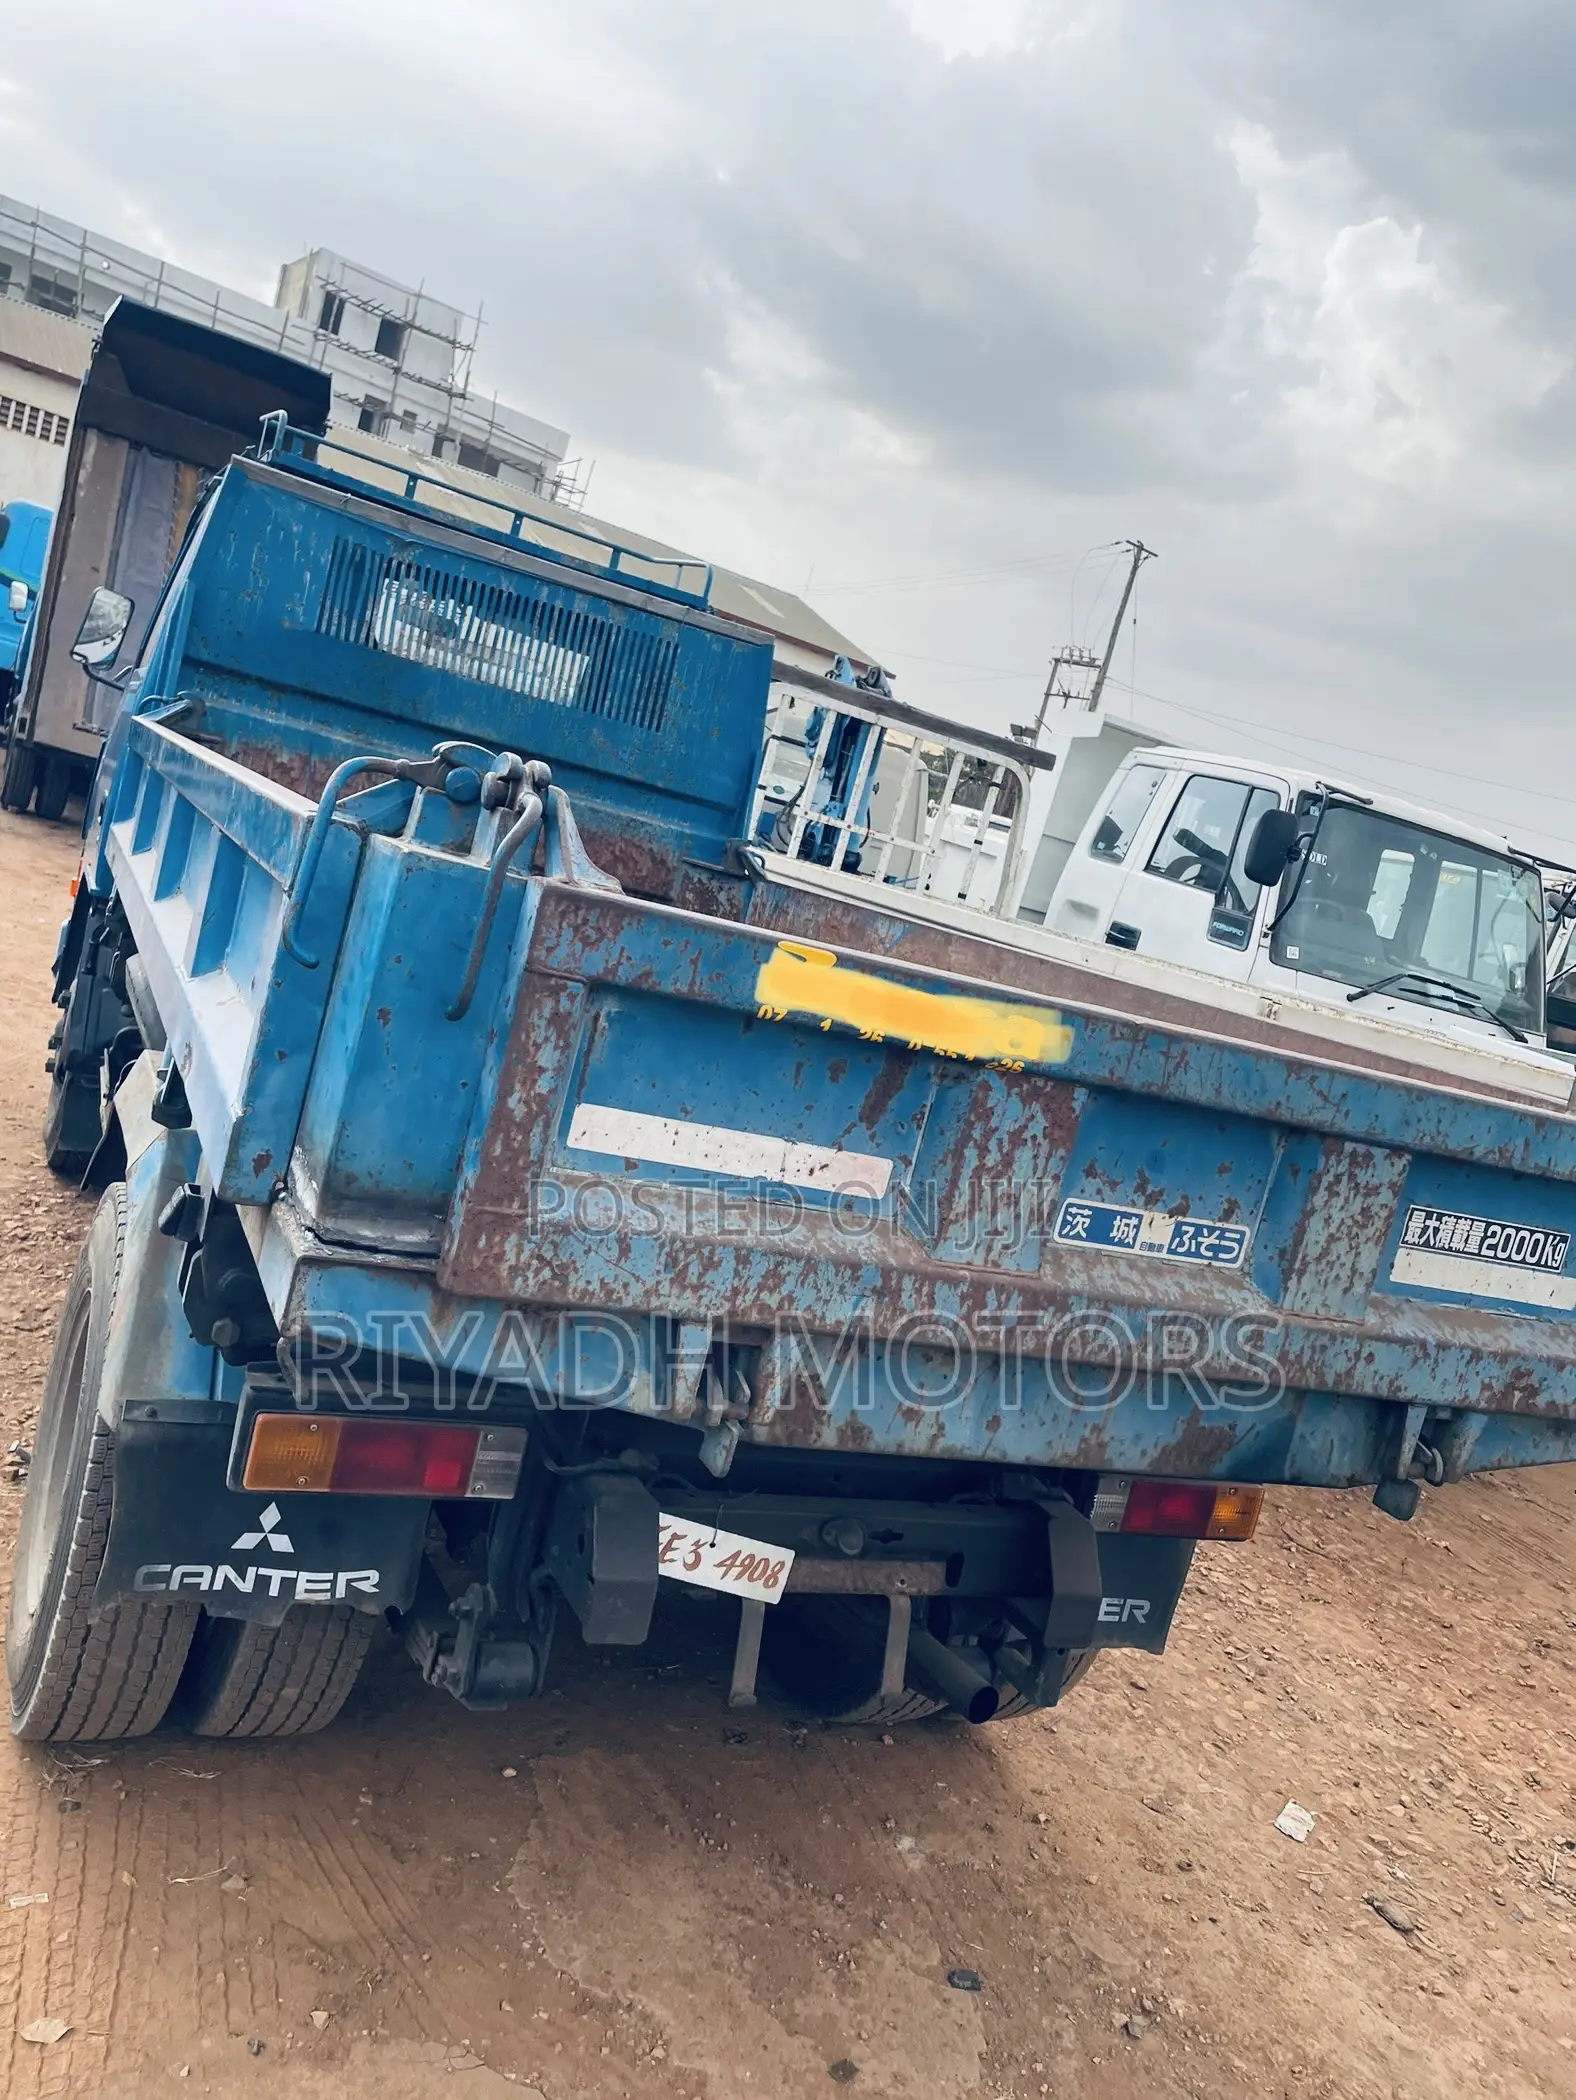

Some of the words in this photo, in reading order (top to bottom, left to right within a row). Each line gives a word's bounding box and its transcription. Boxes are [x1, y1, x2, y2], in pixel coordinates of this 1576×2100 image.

[1166, 1225, 1241, 1260] ふそう
[657, 1524, 710, 1572] E3
[712, 1549, 786, 1590] 4908
[133, 1563, 380, 1600] CANTER
[1097, 1597, 1151, 1624] ER
